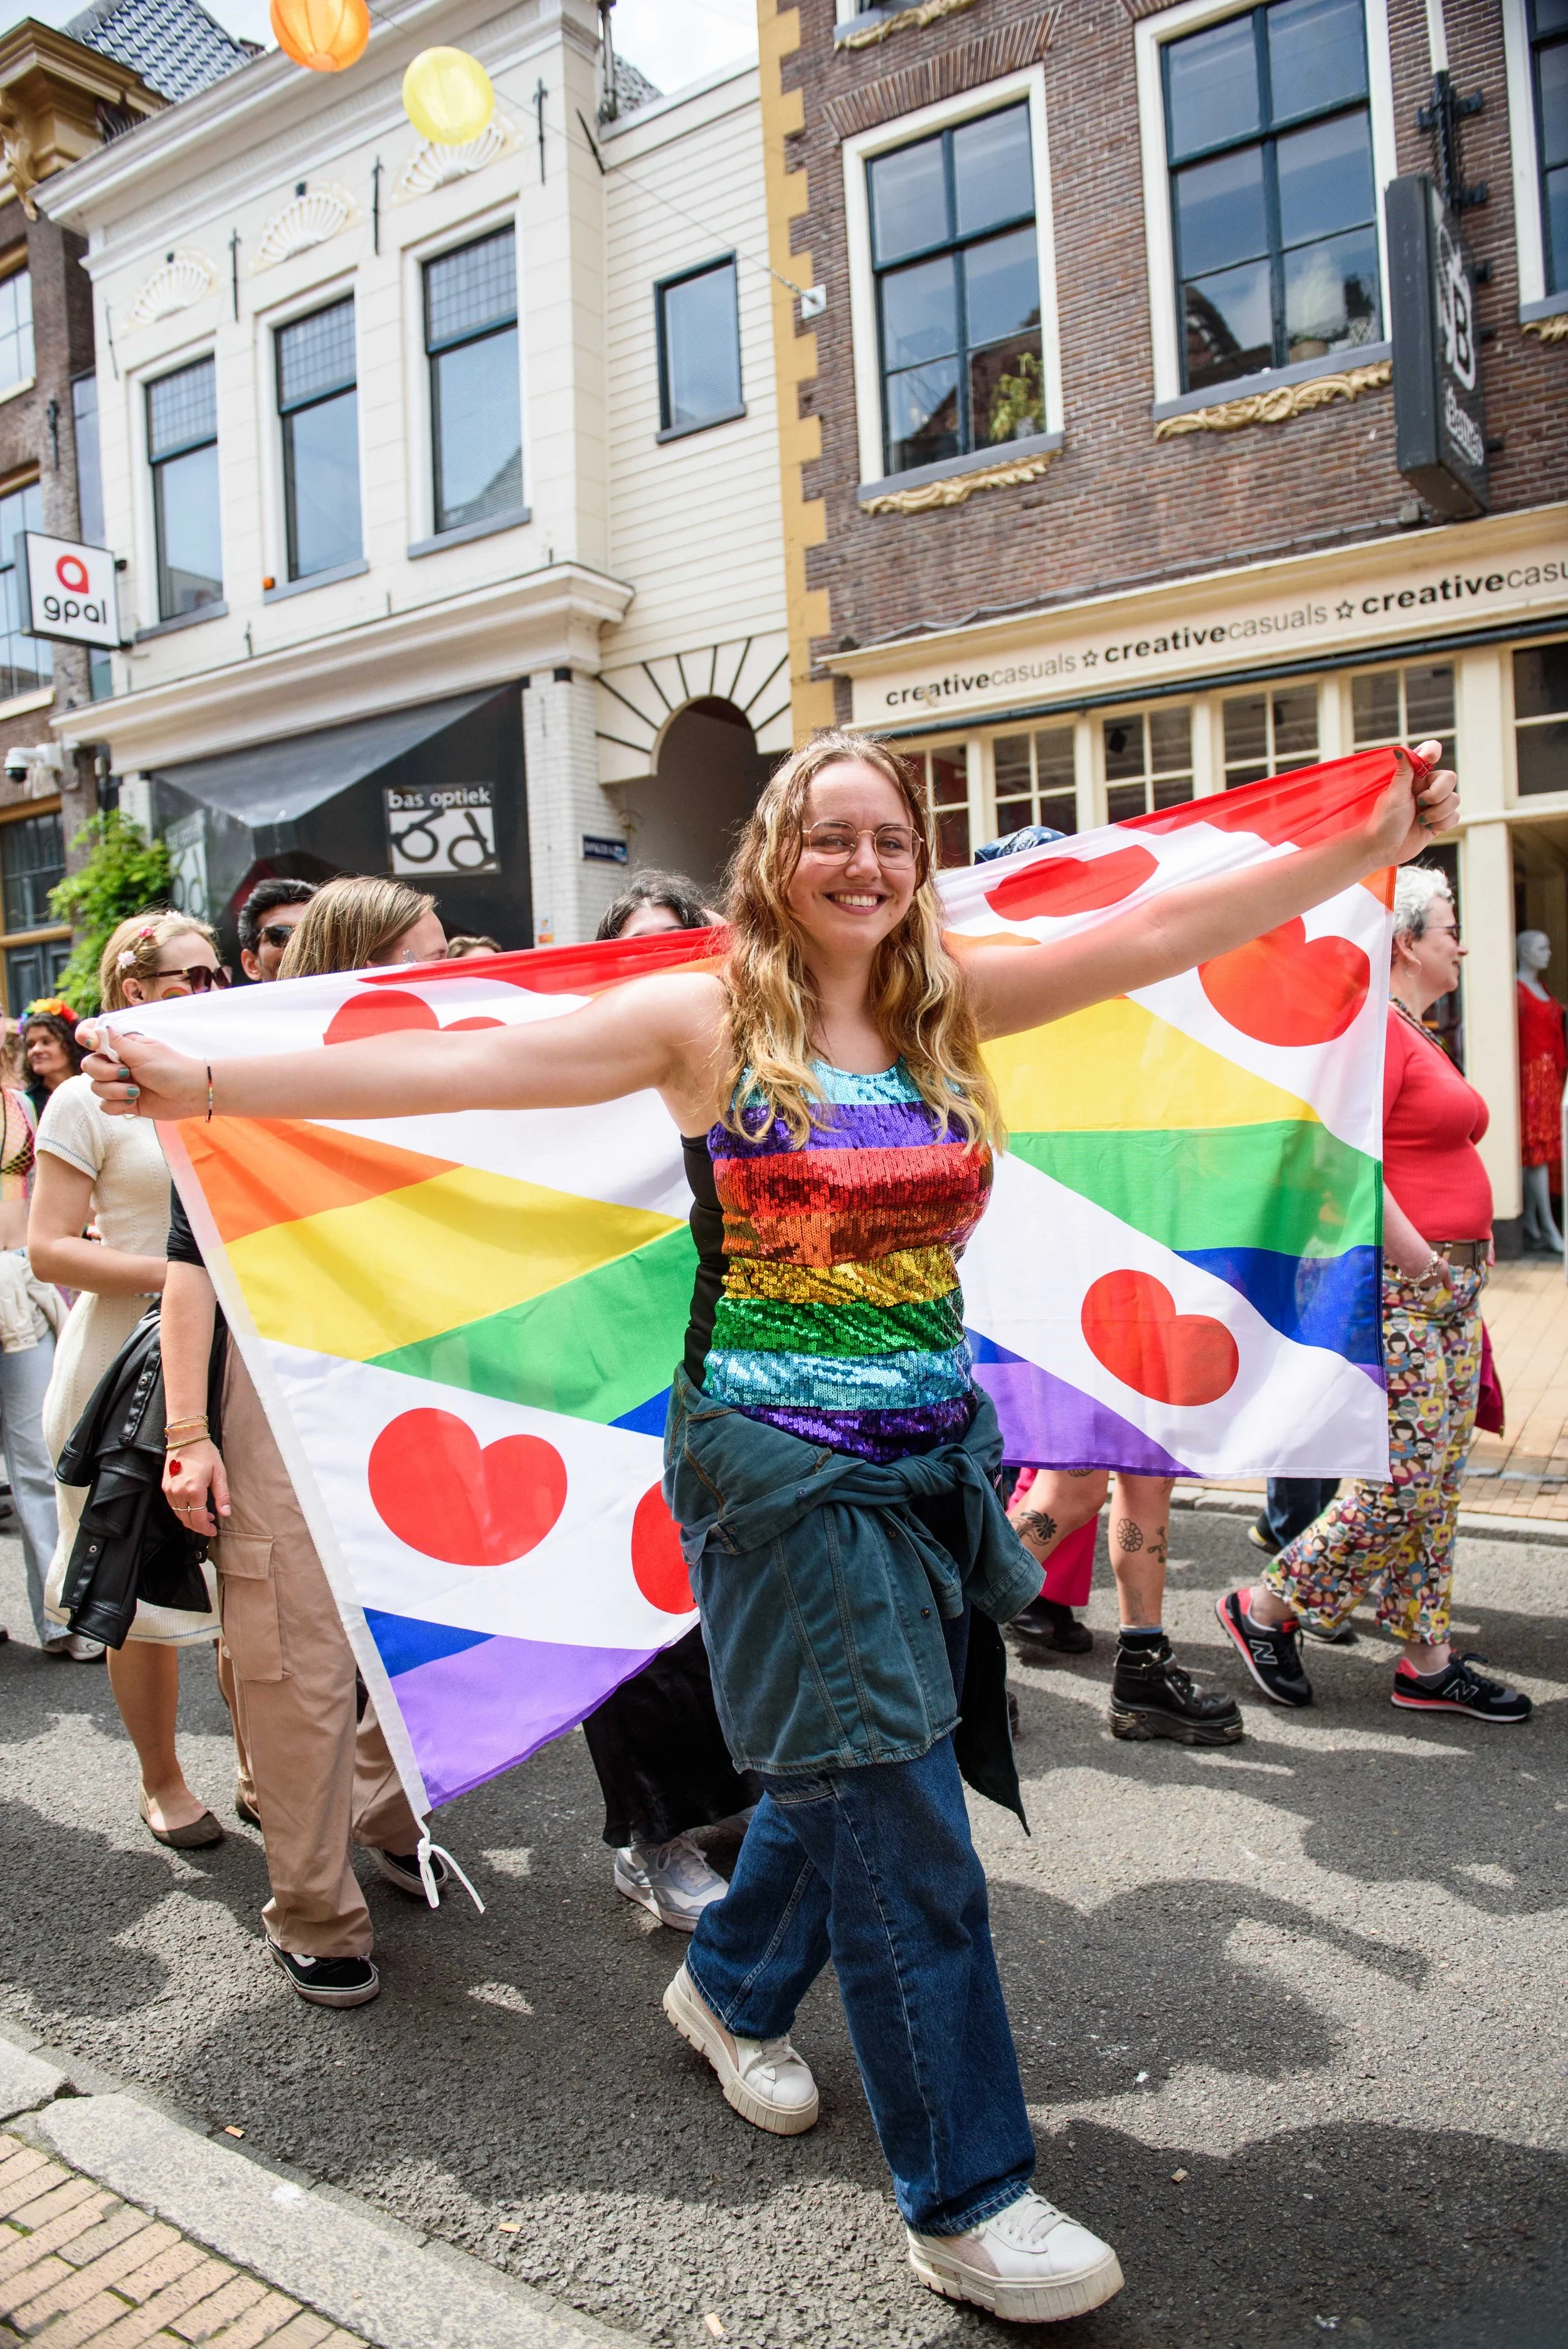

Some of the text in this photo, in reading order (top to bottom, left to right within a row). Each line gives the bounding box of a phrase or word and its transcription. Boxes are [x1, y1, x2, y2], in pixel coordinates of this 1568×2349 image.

[44, 597, 107, 624] gpal
[886, 652, 1077, 706] creativecasuals
[1105, 603, 1328, 662] creativecasuals
[388, 786, 492, 810] bas optiek
